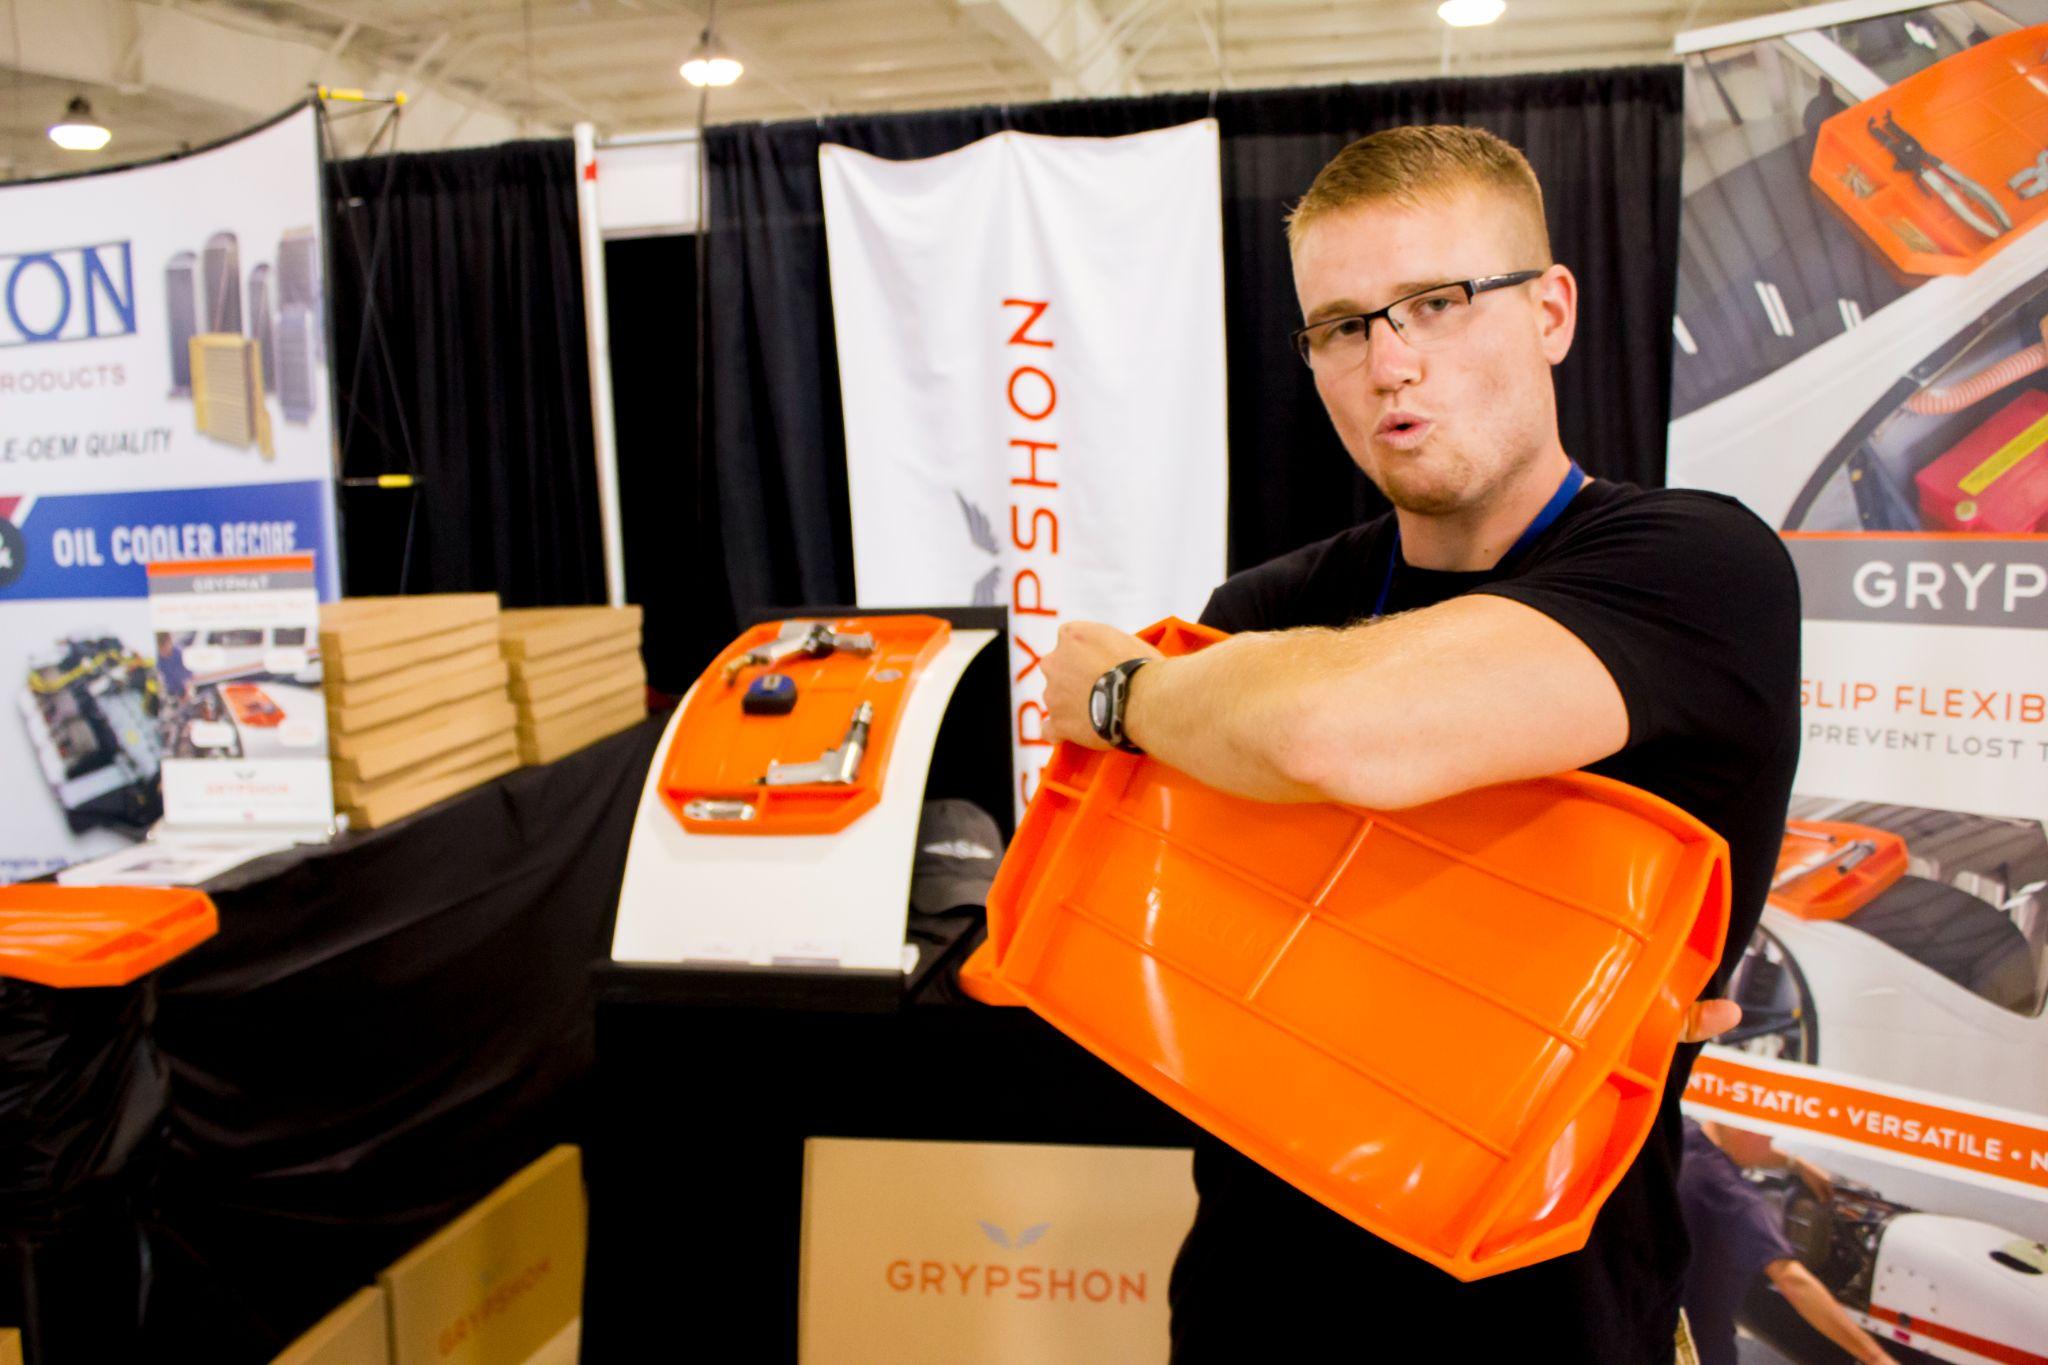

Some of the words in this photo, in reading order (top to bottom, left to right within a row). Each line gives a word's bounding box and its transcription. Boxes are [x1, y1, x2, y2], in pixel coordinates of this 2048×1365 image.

[85, 427, 172, 458] QUALITY
[52, 528, 104, 567] OIL
[111, 522, 216, 565] COOLER
[1853, 560, 2047, 613] GRYP
[1894, 685, 2046, 724] FLEXIB
[1808, 723, 1937, 752] PREVENT
[1945, 735, 2024, 760] LOST
[1847, 1105, 2003, 1163] VERSATILE
[886, 1259, 1148, 1304] GRYPSHON
